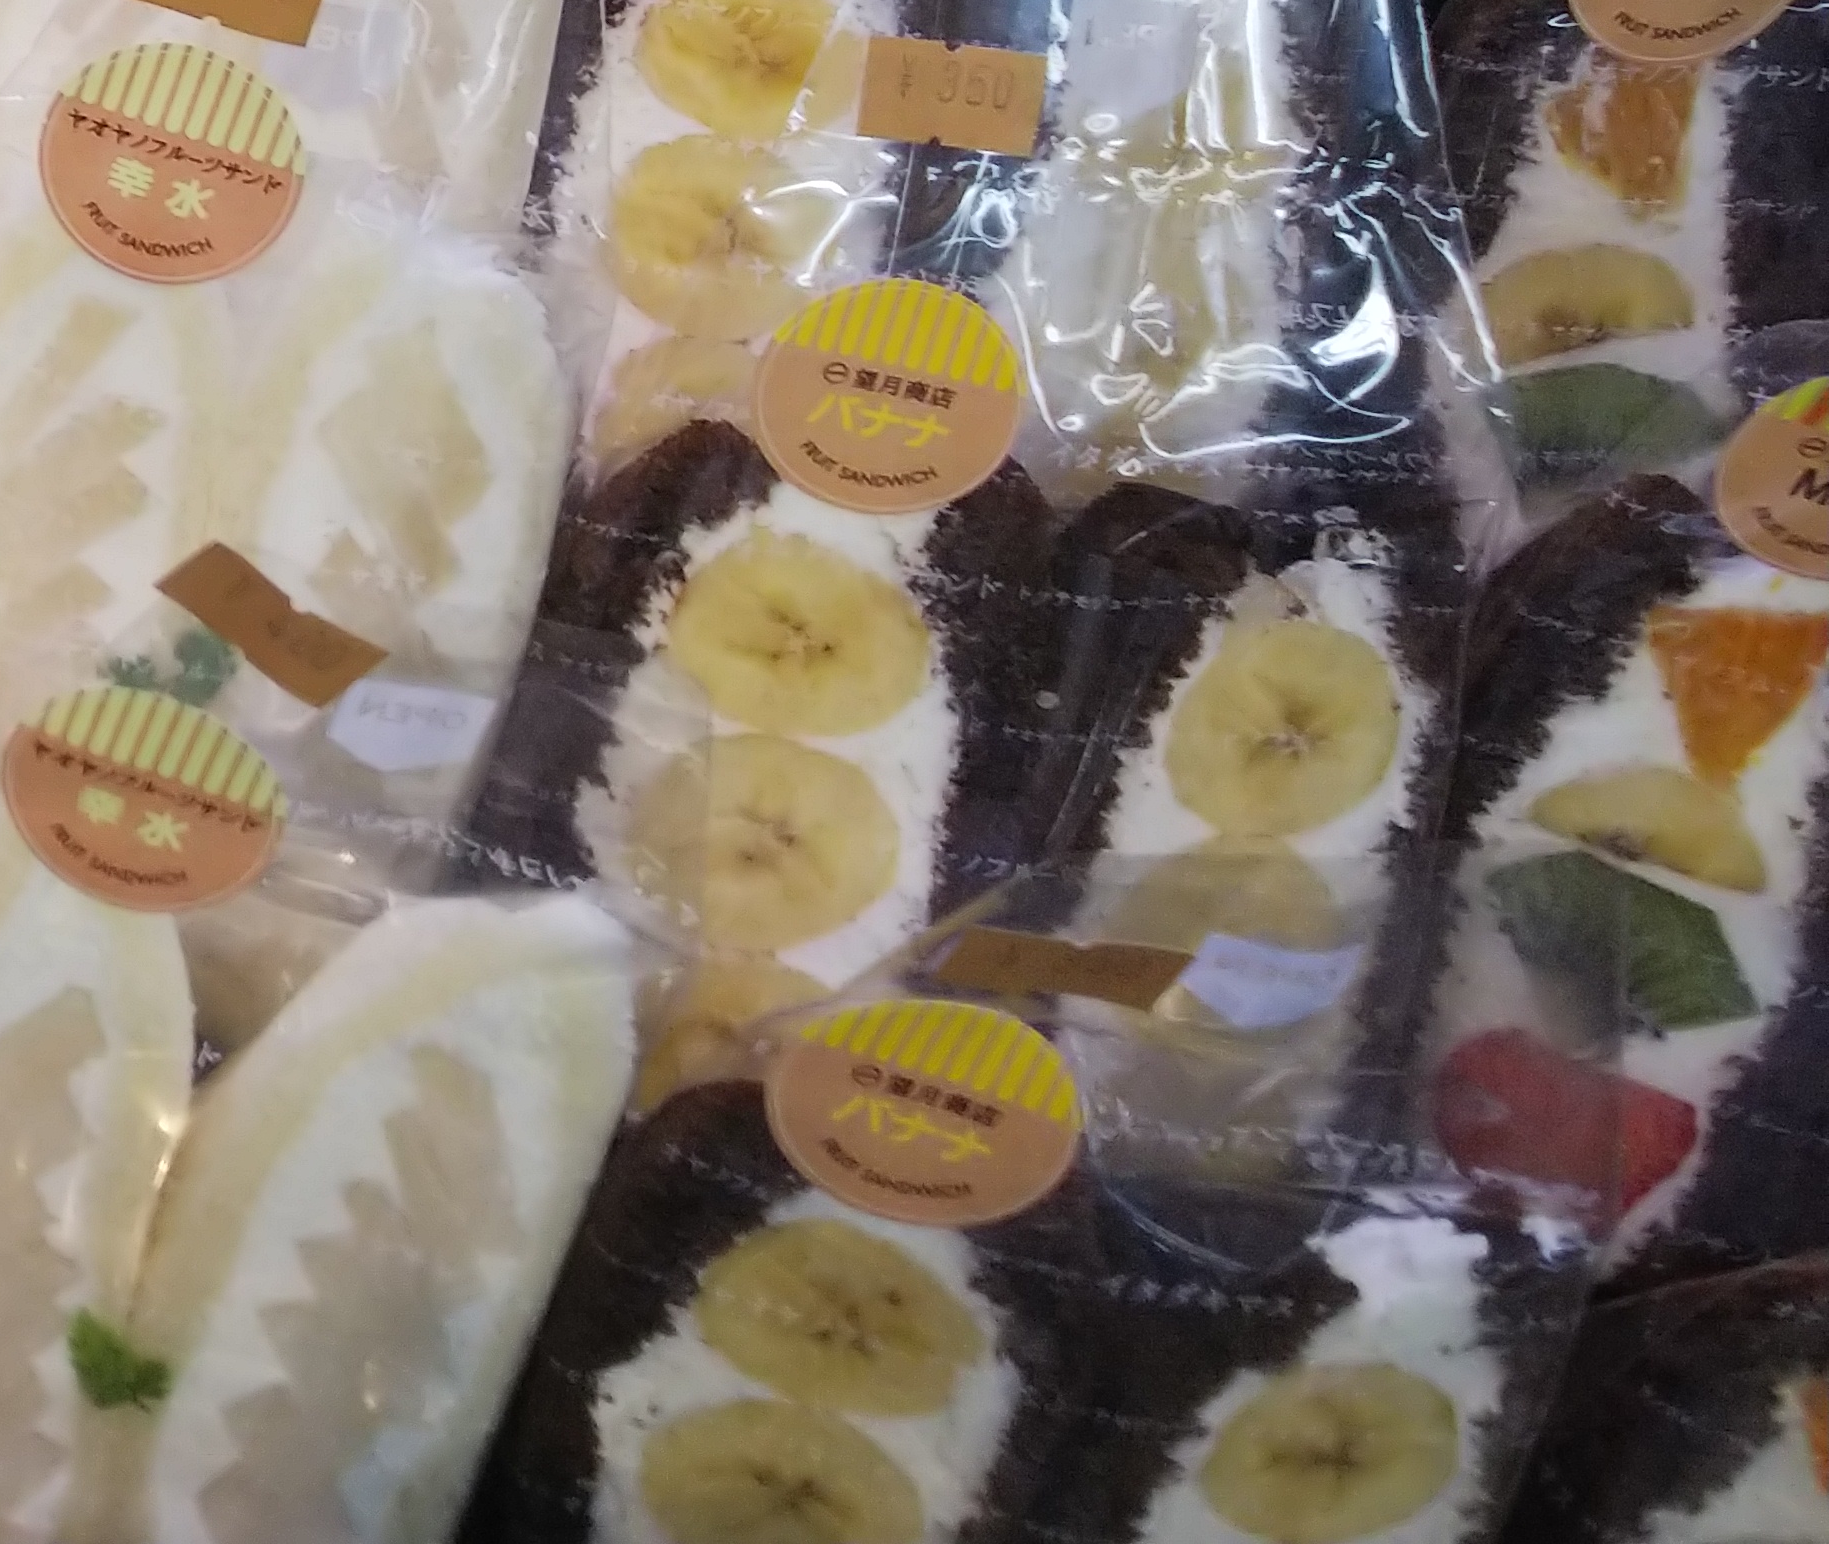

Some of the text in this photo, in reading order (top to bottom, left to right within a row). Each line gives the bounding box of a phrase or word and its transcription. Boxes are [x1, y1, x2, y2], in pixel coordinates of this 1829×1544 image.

[1651, 7, 1743, 41] SANDWICH
[68, 108, 283, 195] ヤオヤノフルーツサンド
[107, 156, 215, 220] 幸水
[83, 201, 214, 257] FRUIT SANDWICH
[851, 367, 958, 410] 望月商店
[806, 393, 952, 449] バナナ
[798, 439, 939, 491] FRUIT SANDWICH
[832, 1095, 994, 1162] バナナ
